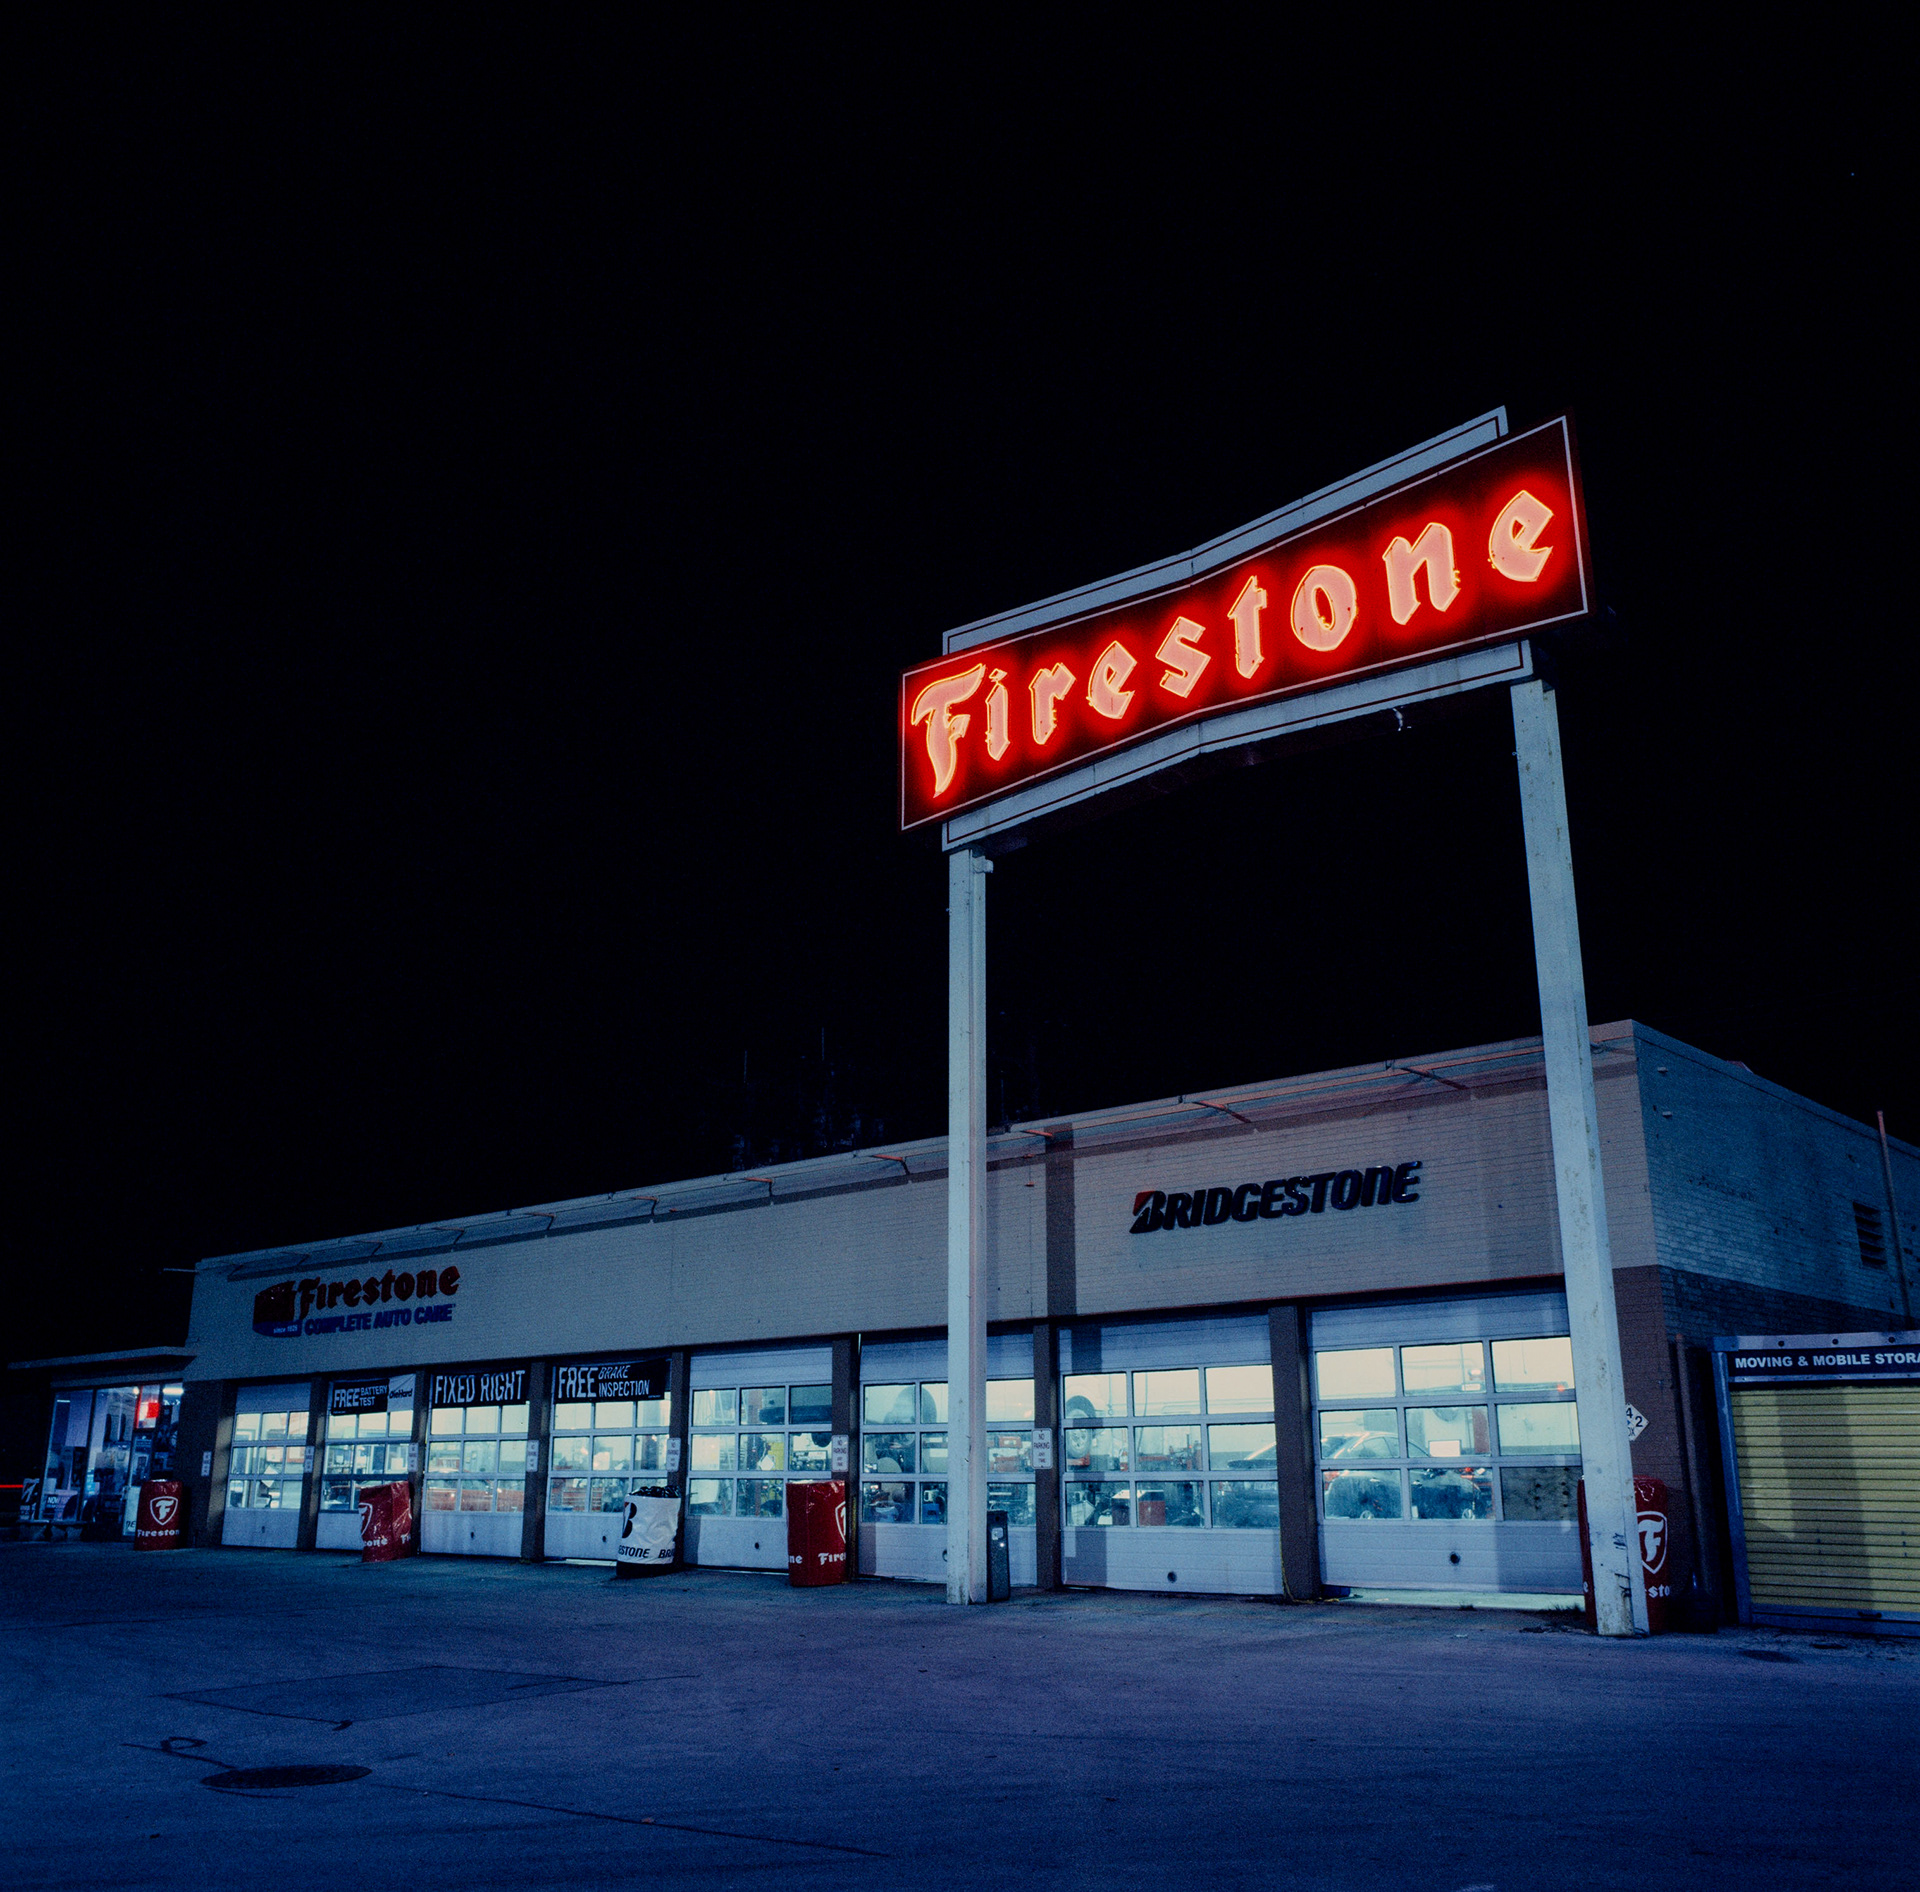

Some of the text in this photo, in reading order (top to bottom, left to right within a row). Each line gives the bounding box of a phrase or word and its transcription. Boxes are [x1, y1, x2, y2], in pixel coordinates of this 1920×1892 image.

[911, 489, 1554, 798] Firestone
[1129, 1160, 1423, 1234] BRIDGESTONE
[298, 1265, 460, 1320] Firestone
[304, 1303, 454, 1336] COMPLETE AUTO CARE
[1734, 1356, 1793, 1368] MOVING
[1797, 1355, 1809, 1366] &
[1812, 1354, 1871, 1366] MOBILE
[598, 1364, 631, 1380] BRAKE
[360, 1384, 387, 1396] BATTERY
[434, 1369, 526, 1404] FIXED RIGHT
[558, 1366, 599, 1399] FREE
[598, 1380, 650, 1397] INSPECTION
[333, 1387, 360, 1408] FREE
[359, 1396, 375, 1406] TEST
[1635, 1415, 1643, 1428] 2
[1645, 1583, 1671, 1598] sto
